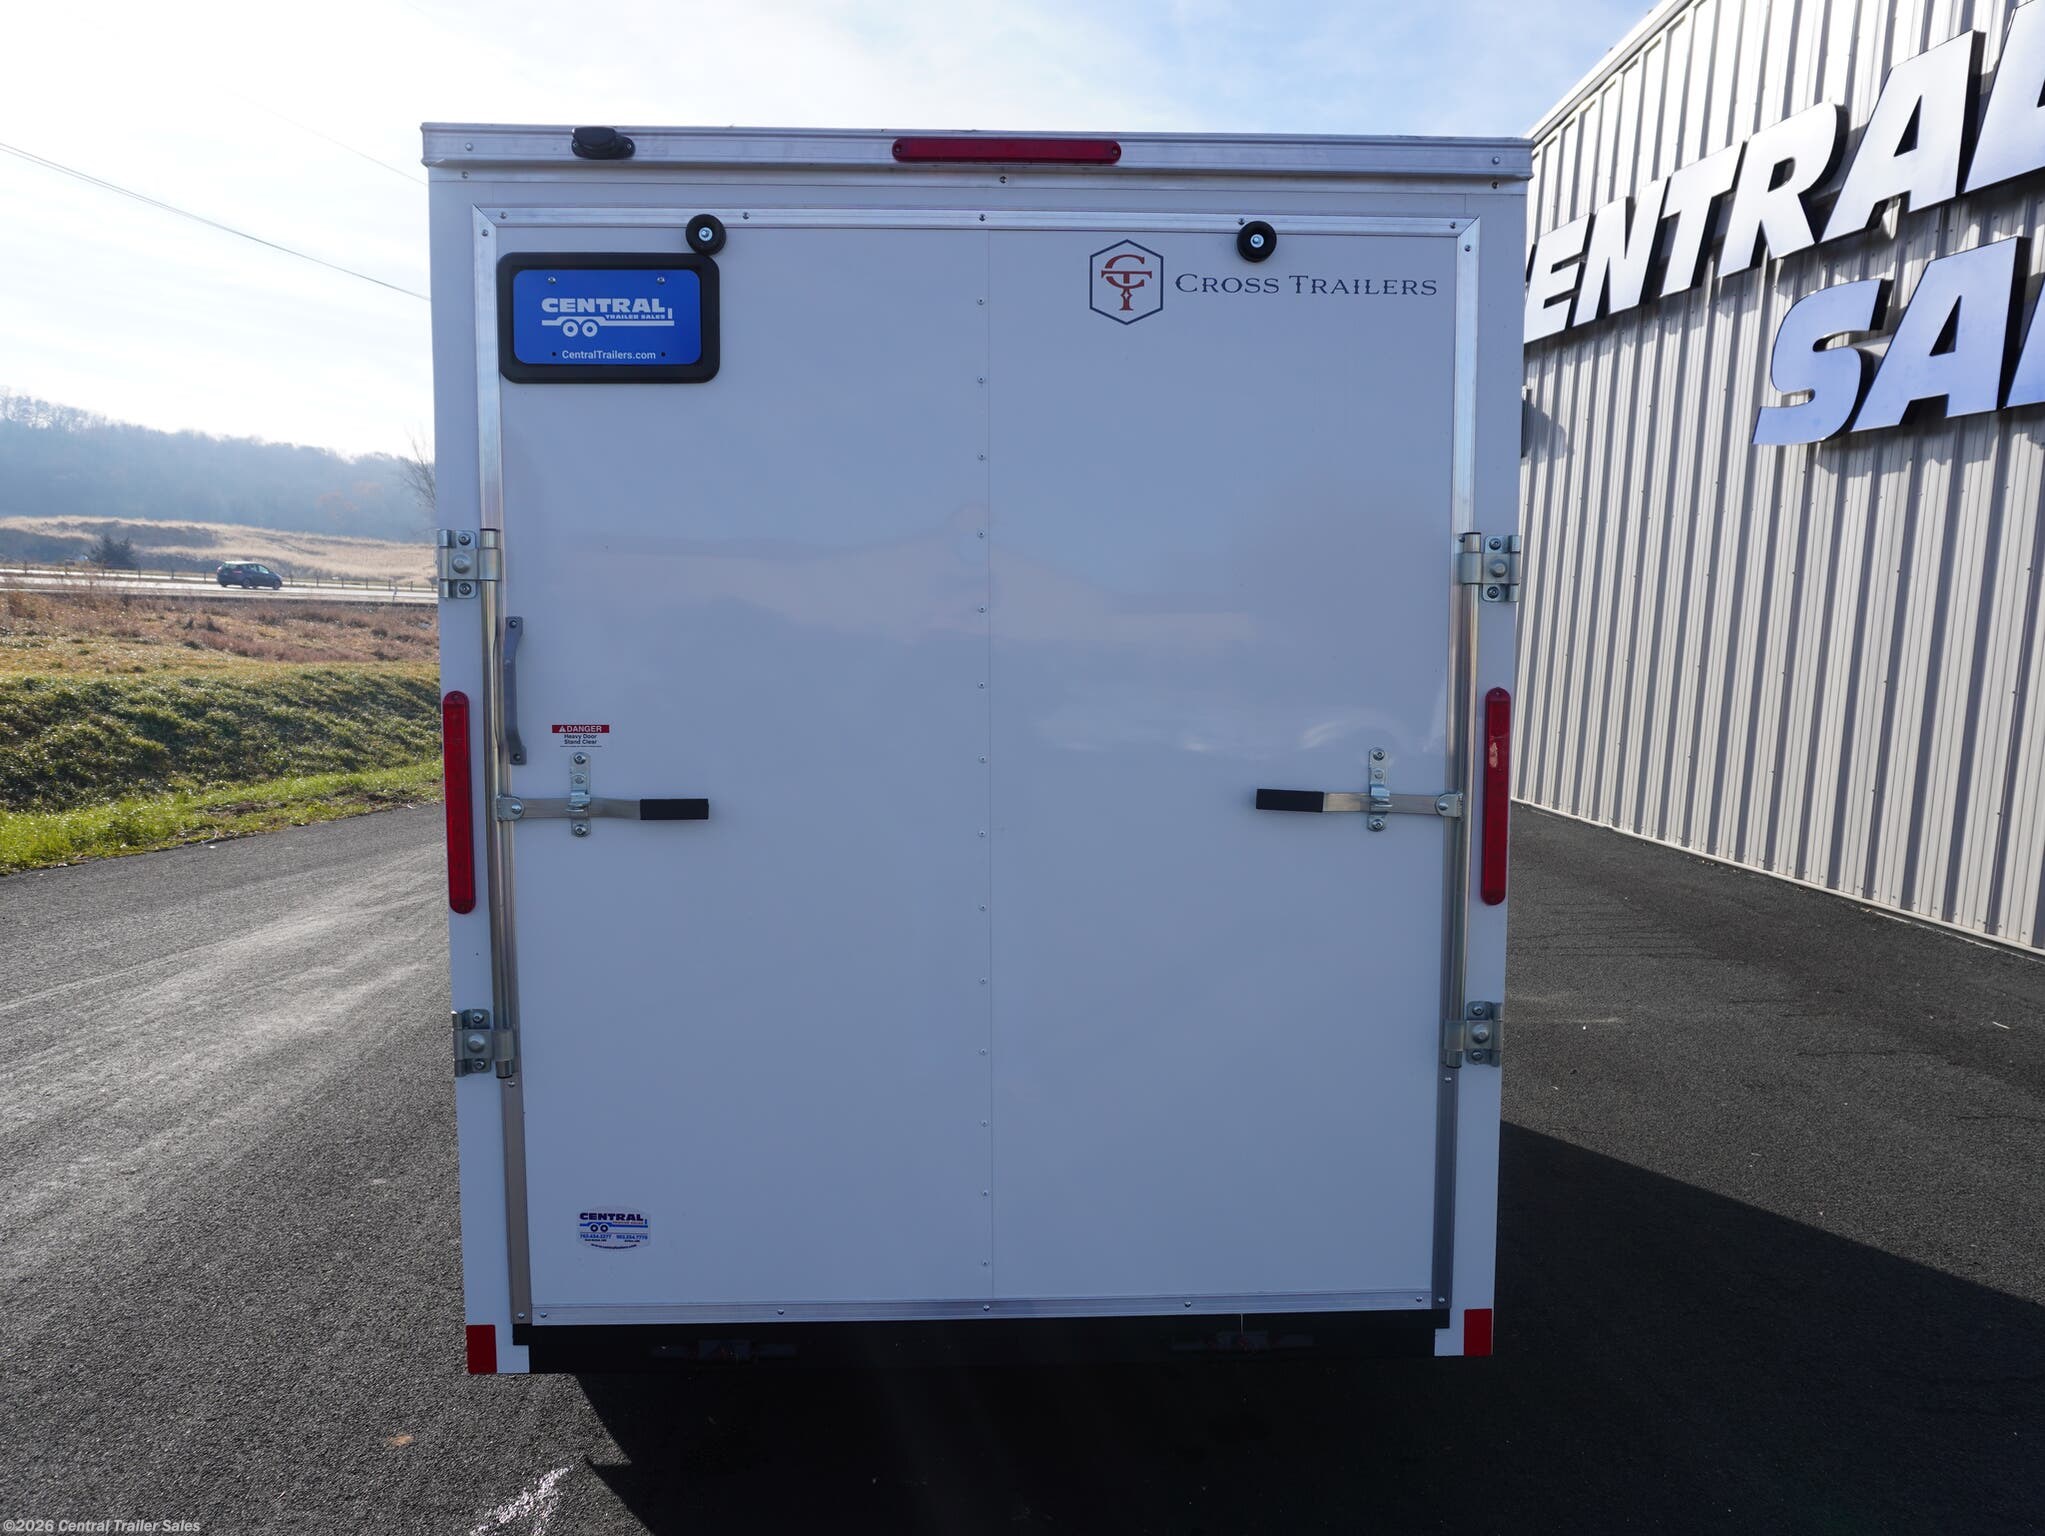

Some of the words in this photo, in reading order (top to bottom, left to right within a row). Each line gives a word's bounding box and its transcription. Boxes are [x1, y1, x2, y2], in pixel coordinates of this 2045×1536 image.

[1524, 0, 2045, 344] ENTRAL
[541, 298, 665, 313] CENTRAL
[1753, 236, 2045, 445] SA
[562, 350, 656, 360] CentralTrailers.com
[580, 1213, 643, 1221] CENTRAL
